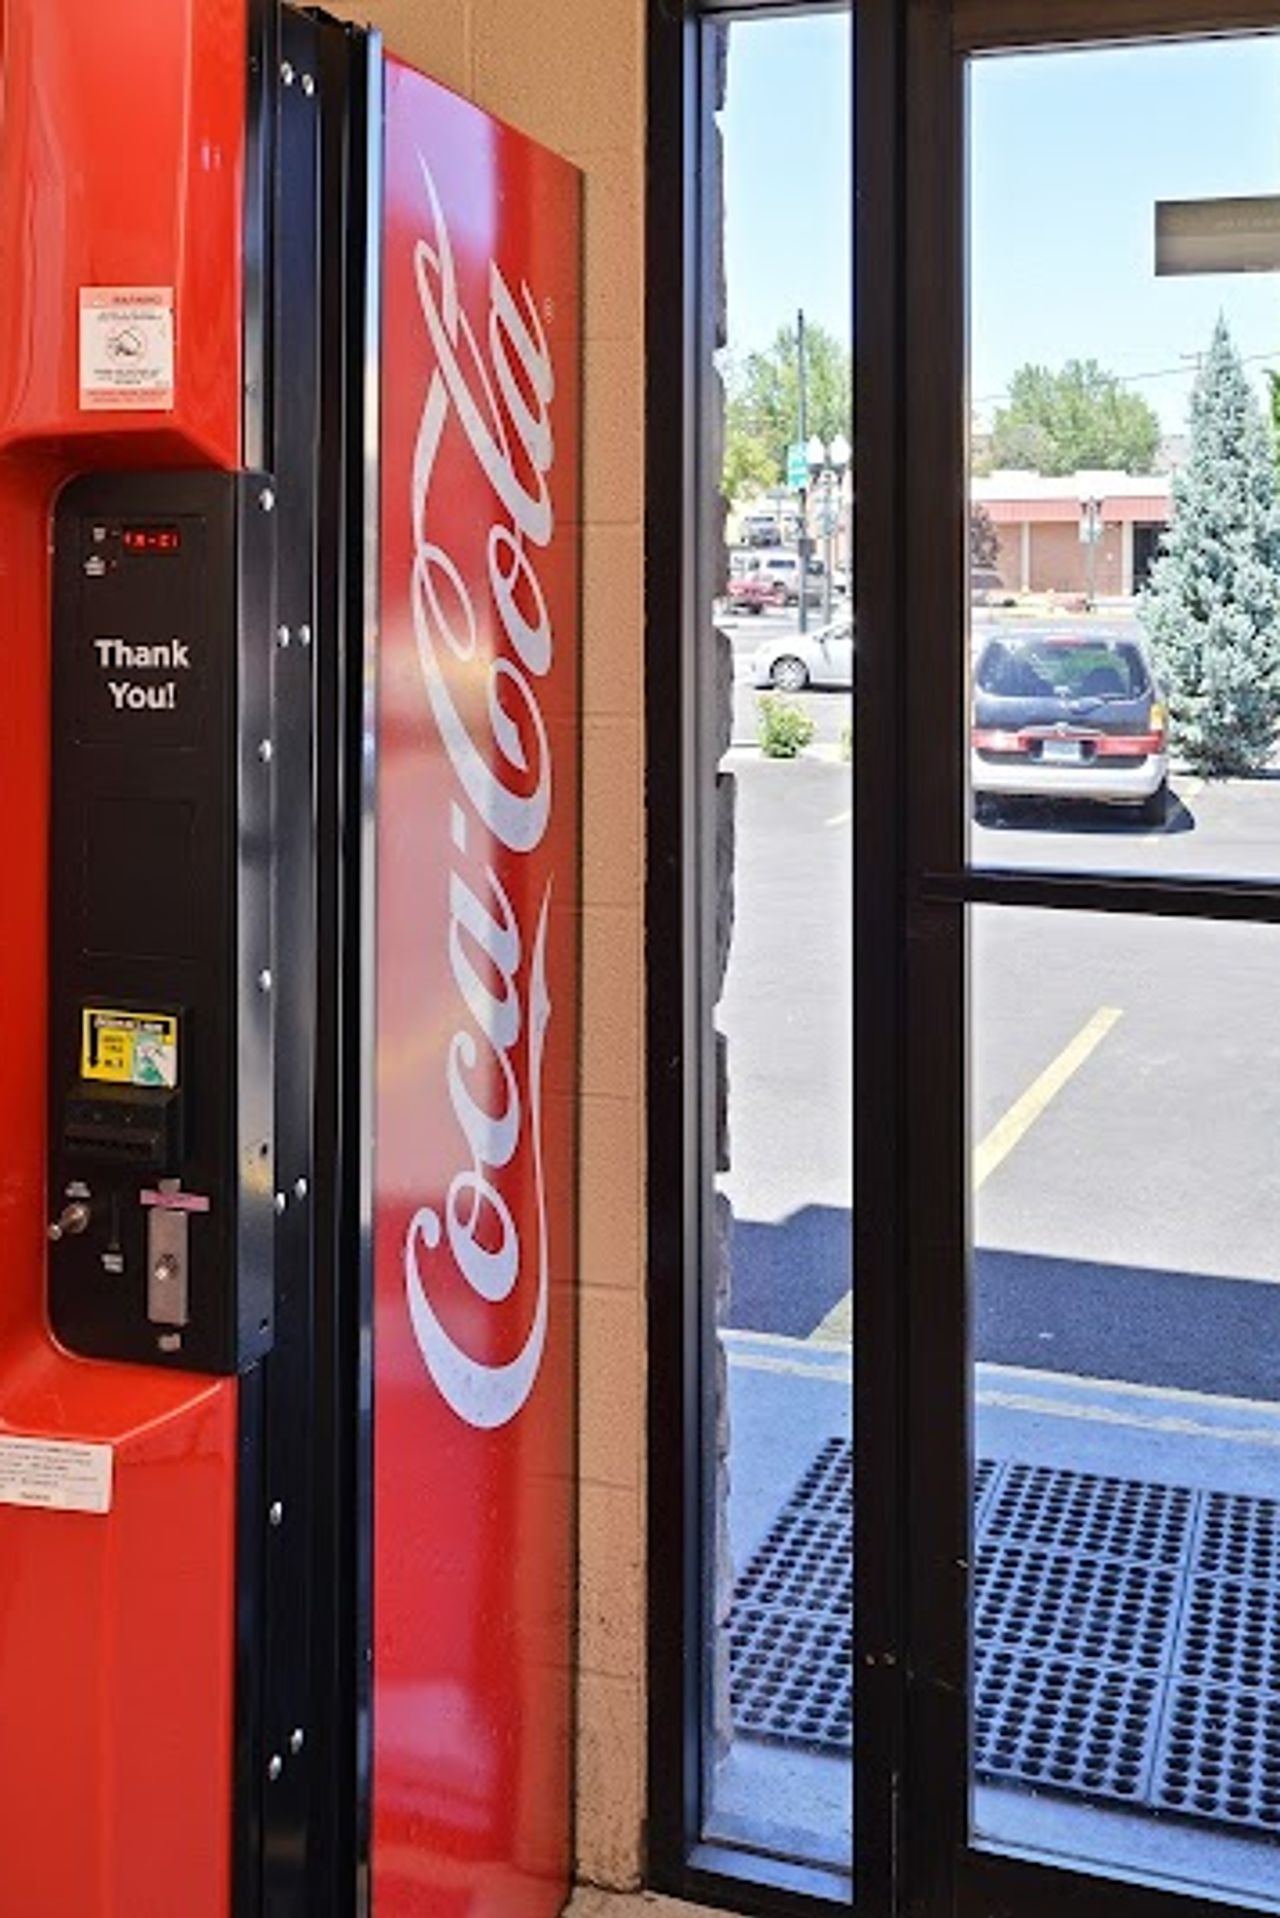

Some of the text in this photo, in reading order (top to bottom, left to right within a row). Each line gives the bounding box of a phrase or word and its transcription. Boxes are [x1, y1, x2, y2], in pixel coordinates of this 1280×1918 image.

[94, 639, 190, 668] Thank
[108, 682, 176, 709] You!
[406, 149, 555, 1428] Coca-Cola
